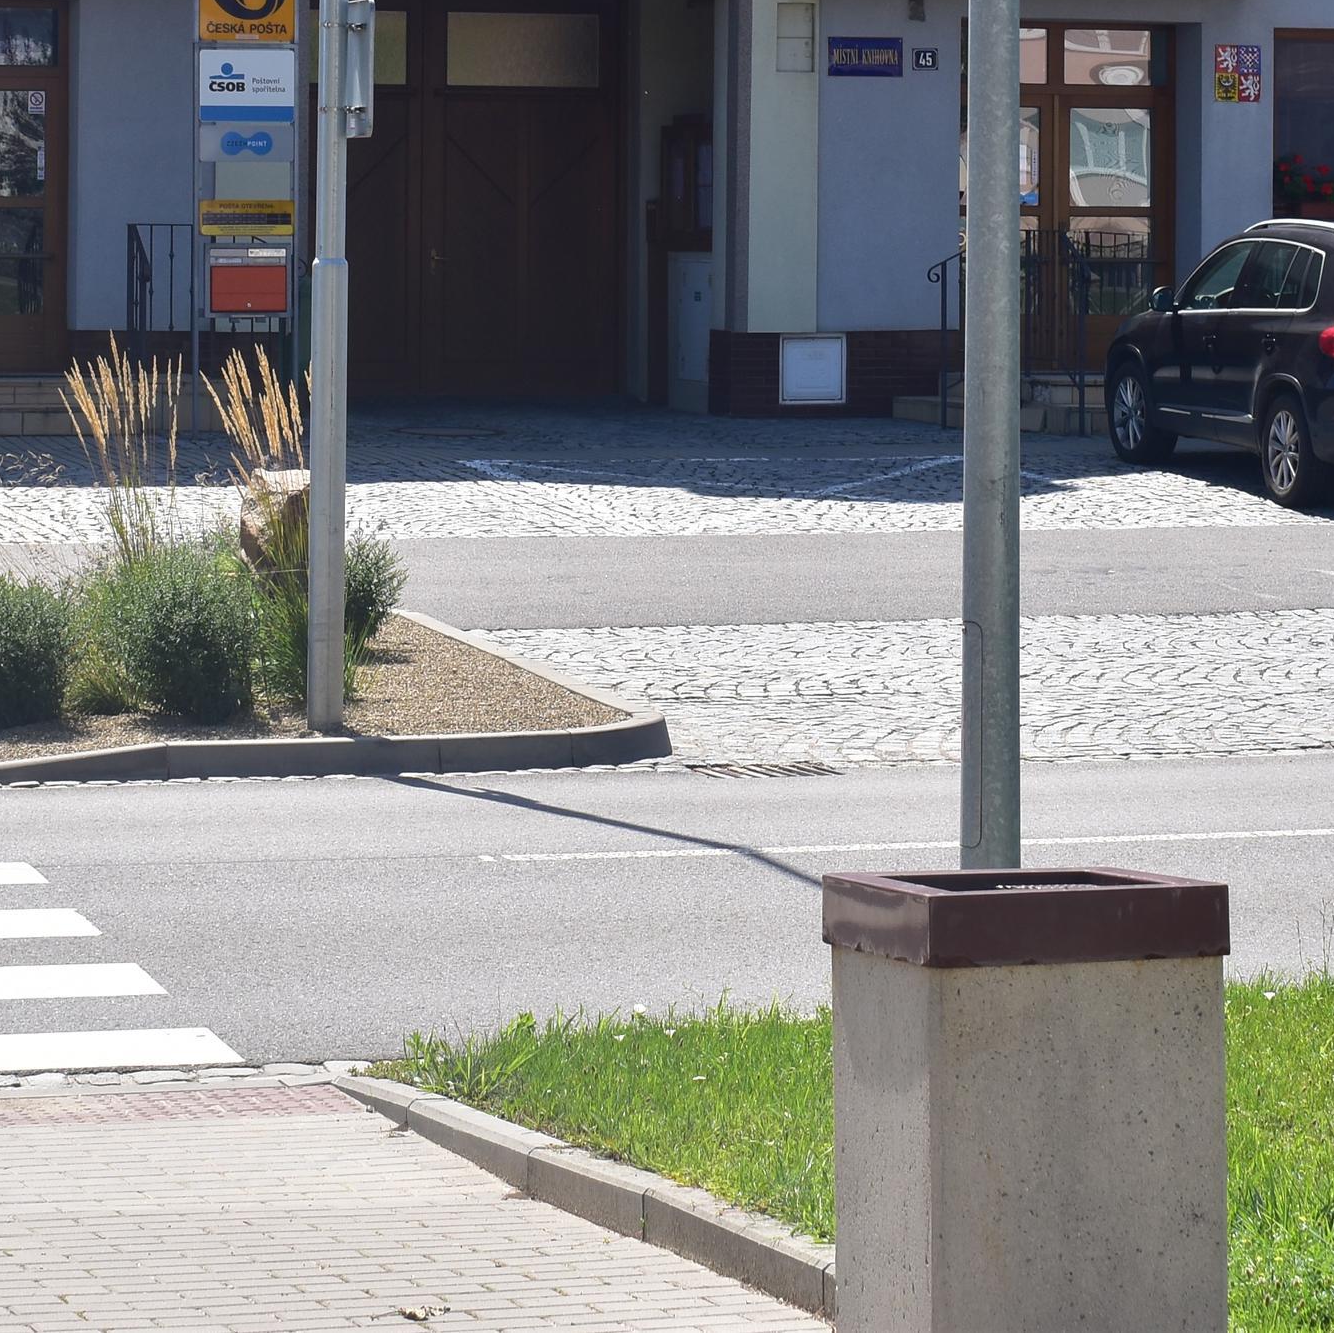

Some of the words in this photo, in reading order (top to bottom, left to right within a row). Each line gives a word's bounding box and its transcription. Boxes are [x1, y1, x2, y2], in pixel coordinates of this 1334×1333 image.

[206, 21, 245, 34] ČESKÁ
[250, 22, 287, 34] POŠTA
[833, 45, 859, 65] MÍSTNÍ
[862, 48, 898, 65] KNIHOVNA
[919, 52, 933, 66] 45
[209, 80, 246, 92] ČSOB
[252, 84, 286, 93] spořitelna
